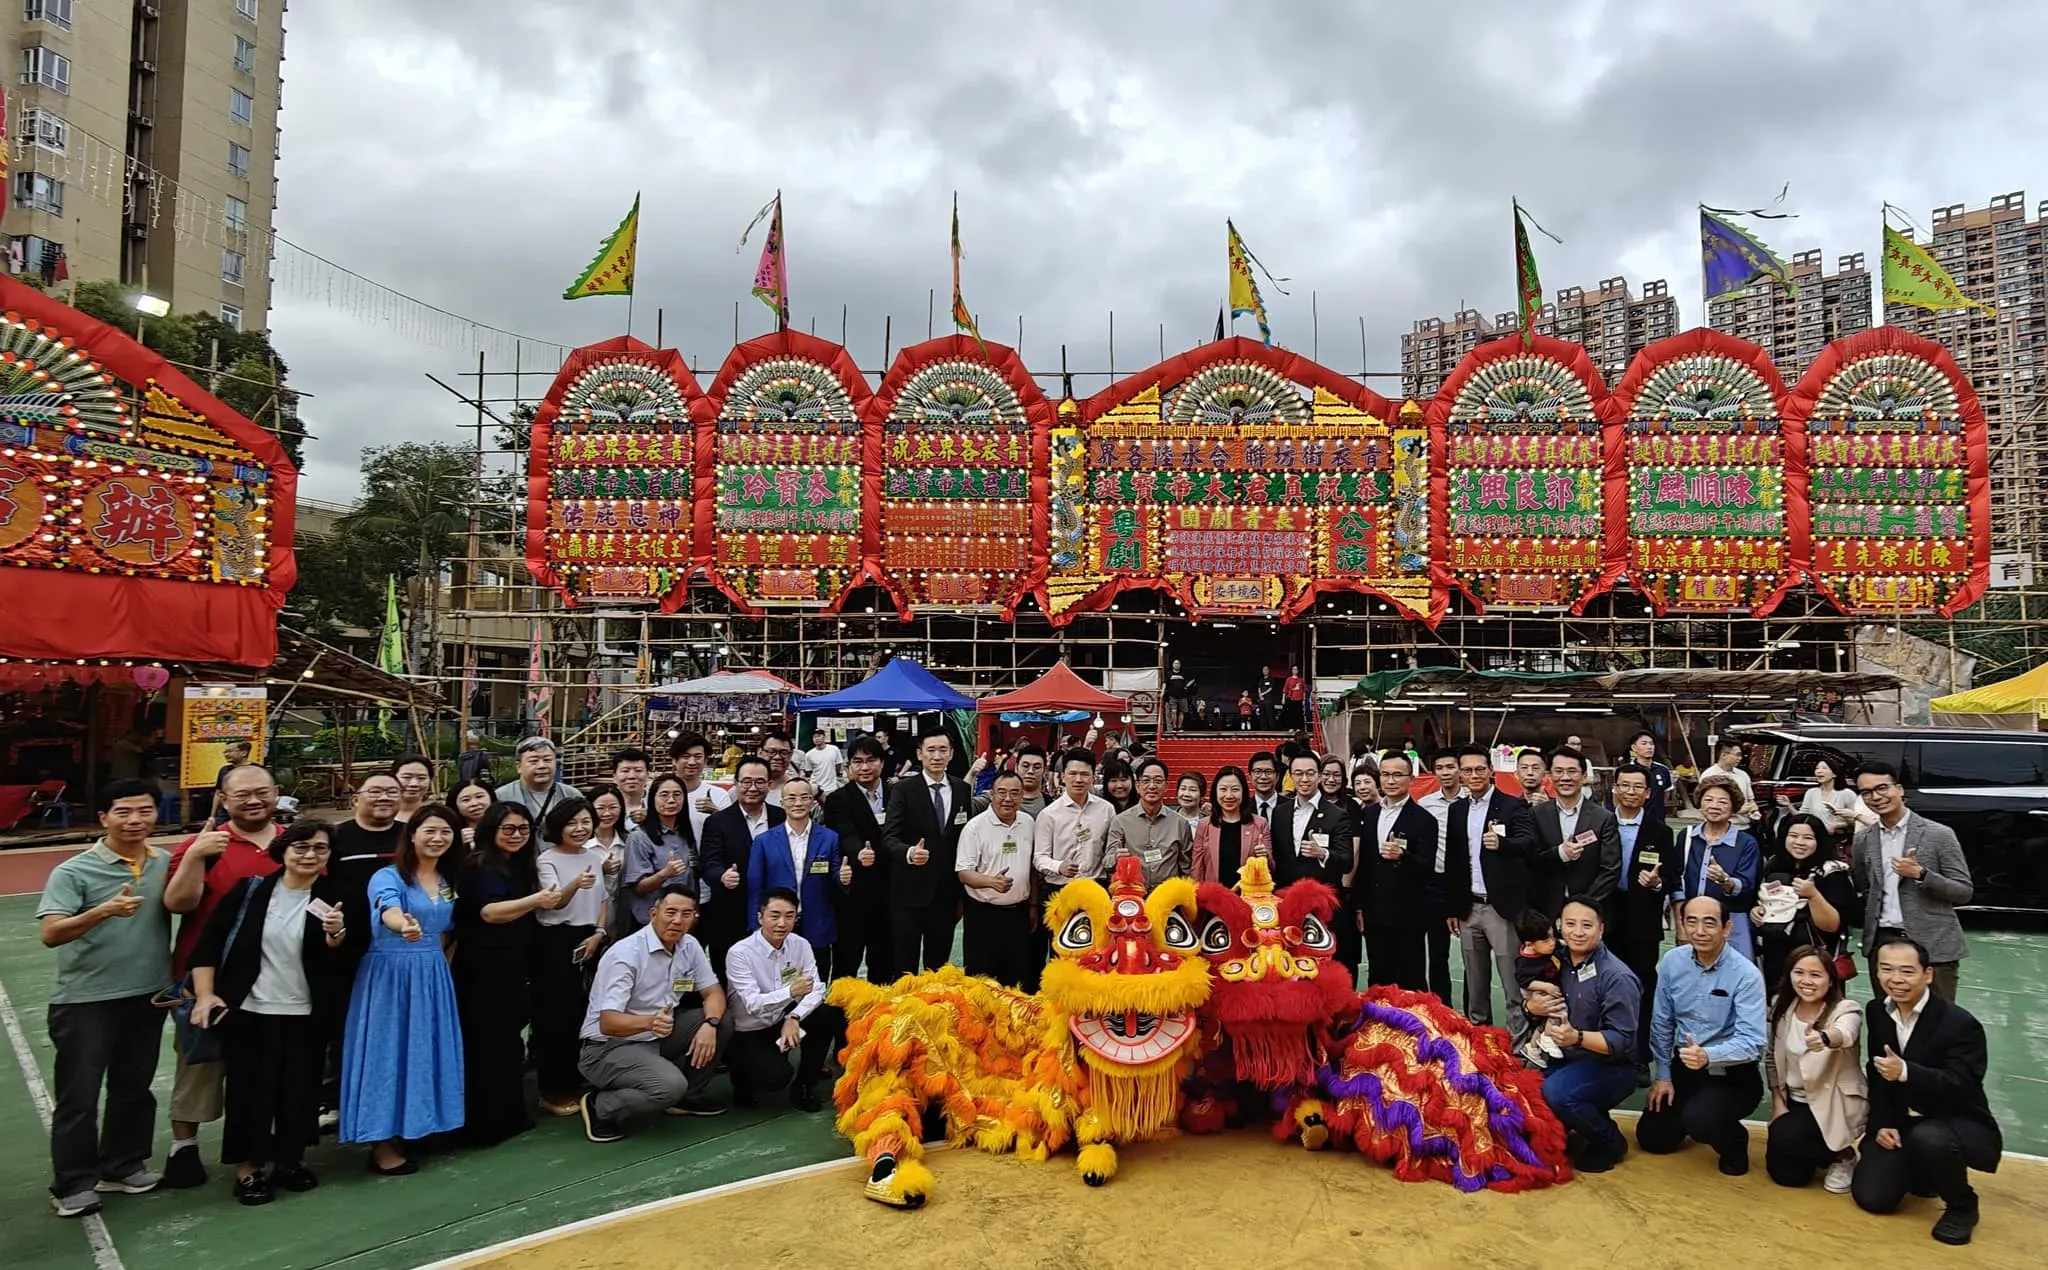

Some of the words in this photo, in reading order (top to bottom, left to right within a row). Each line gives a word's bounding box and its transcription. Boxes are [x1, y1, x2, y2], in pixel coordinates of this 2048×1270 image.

[892, 438, 1023, 462] 青衣各界恭祝
[1094, 474, 1386, 502] 恭祝真君大帝寶誕
[1476, 472, 1574, 511] 郭良興
[1656, 471, 1756, 508] 陳順麟
[562, 502, 681, 529] 神恩庇佑
[1104, 508, 1143, 571] 粵劇
[1334, 511, 1373, 573] 公演
